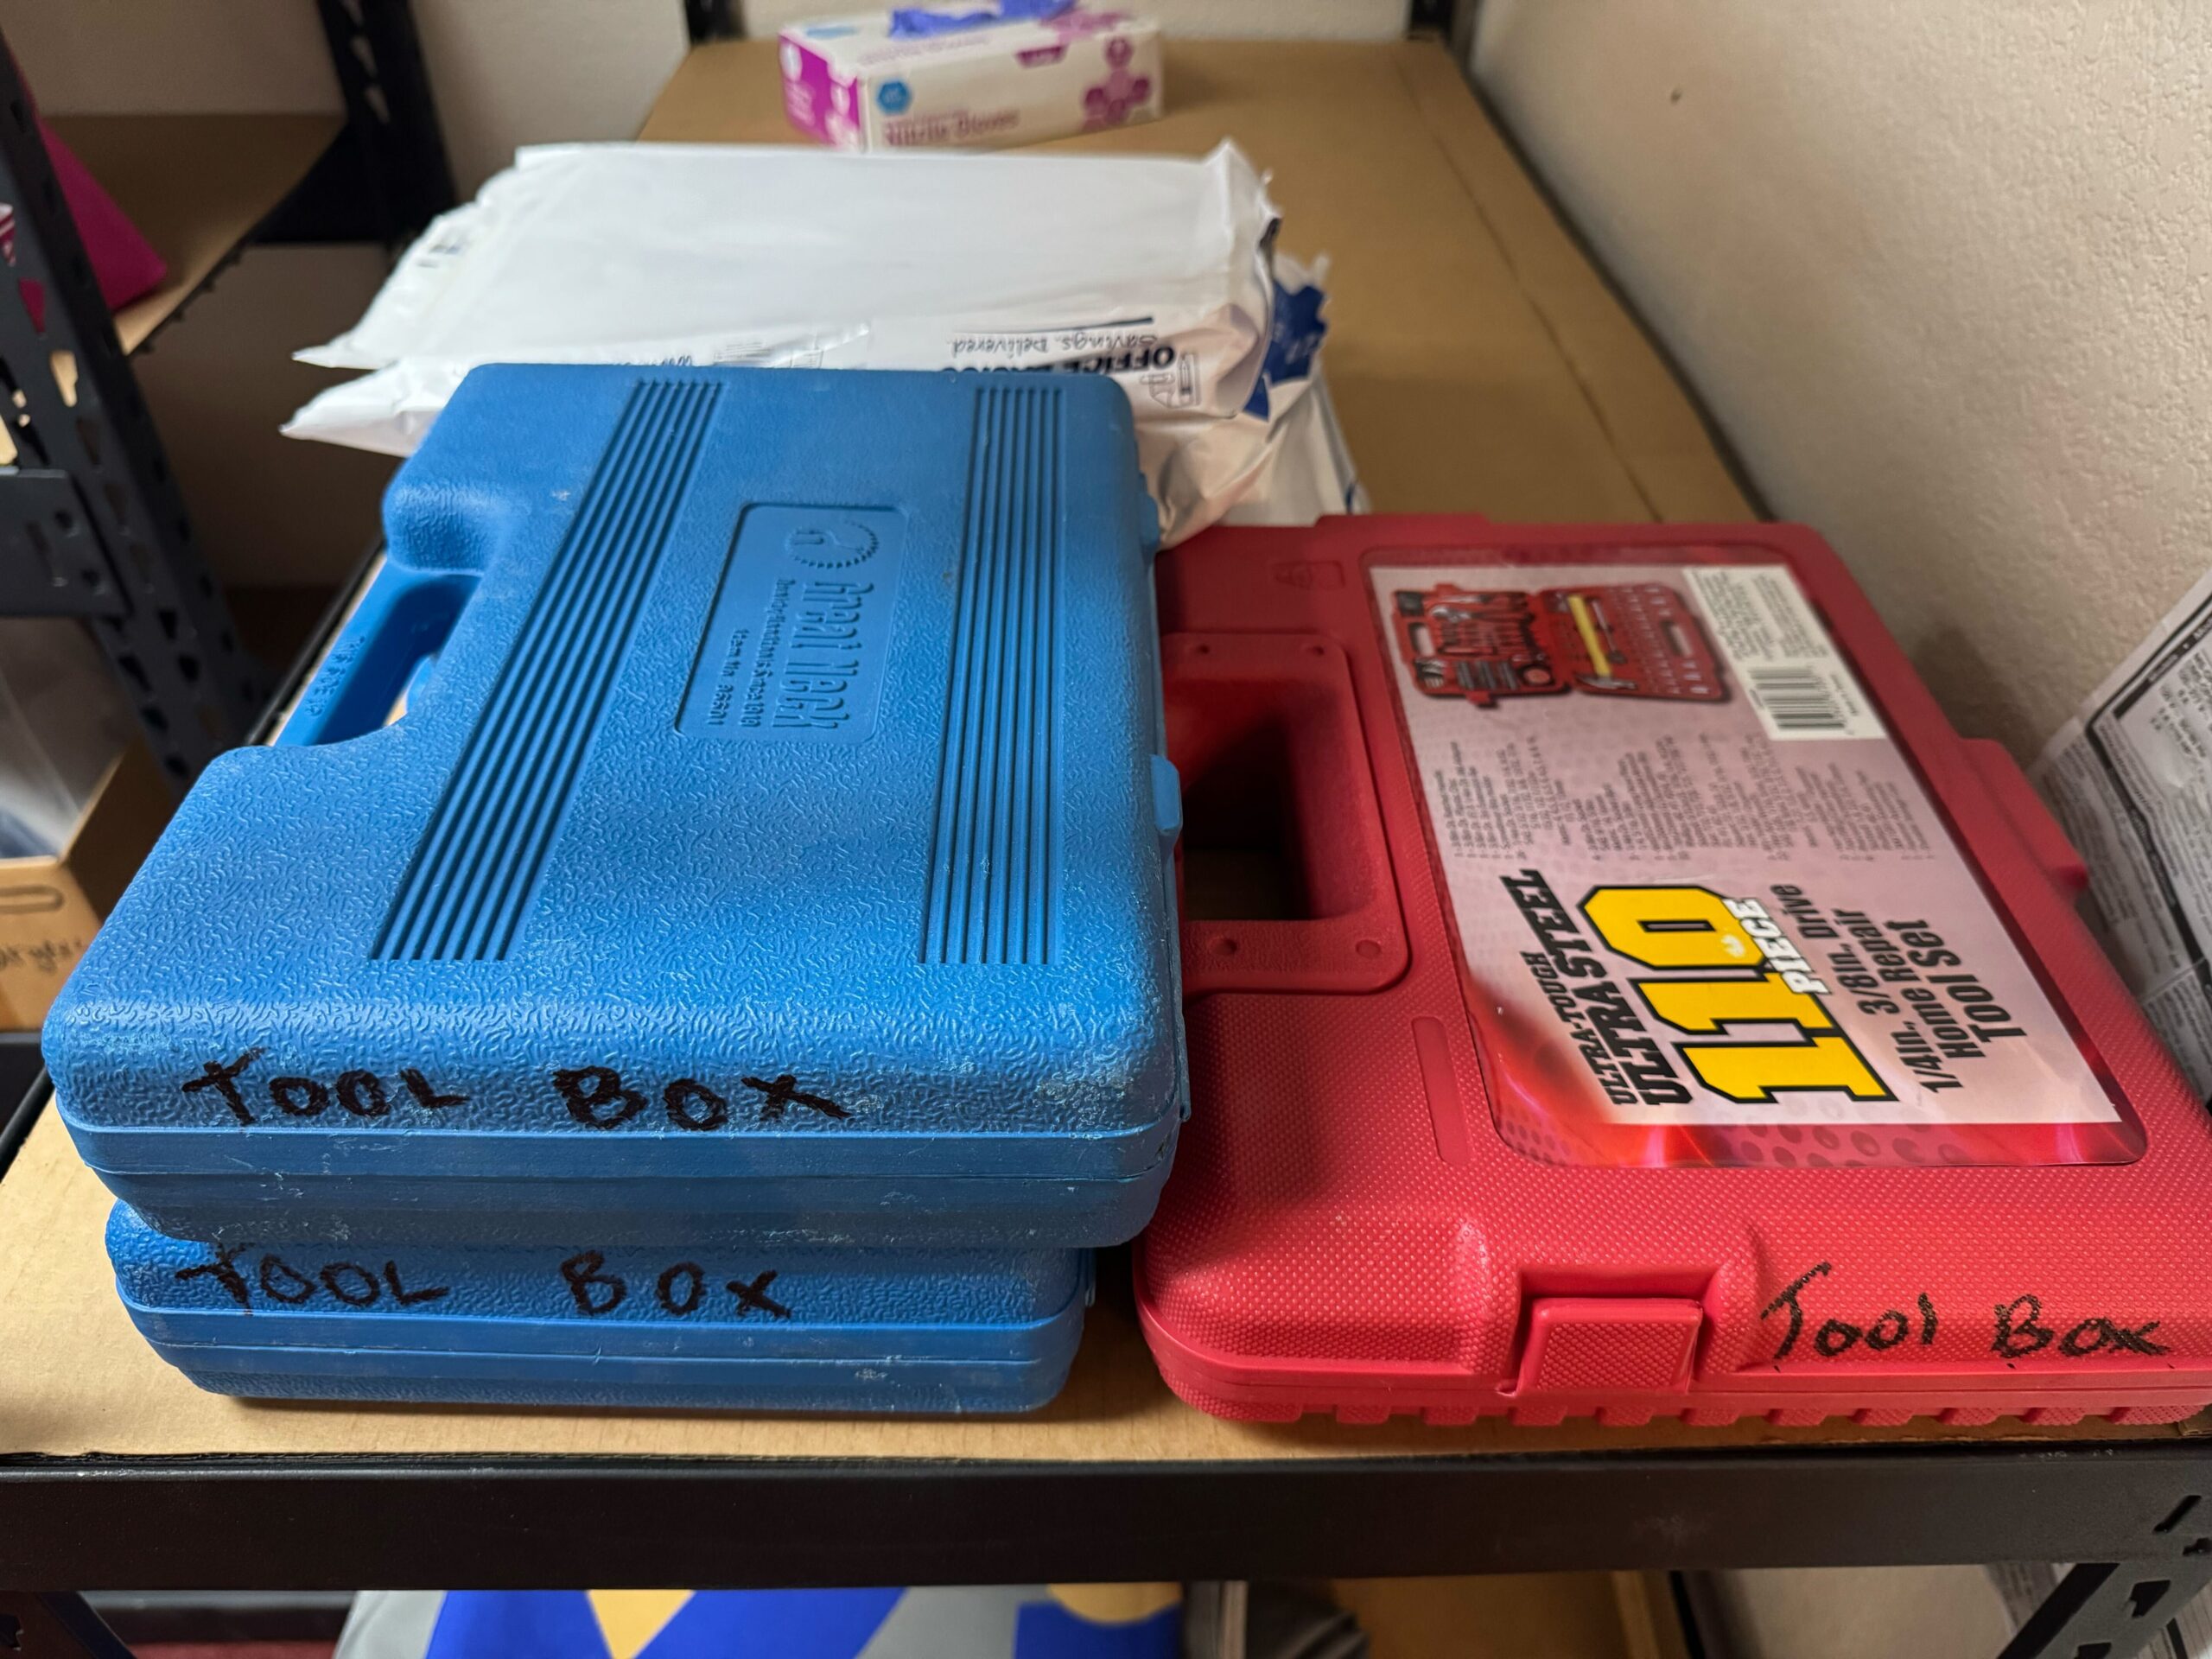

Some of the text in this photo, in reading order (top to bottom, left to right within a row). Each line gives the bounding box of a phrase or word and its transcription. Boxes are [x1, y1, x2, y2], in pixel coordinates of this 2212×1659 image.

[772, 582, 874, 728] Great Neck
[1499, 868, 1607, 978] STEEL
[1721, 897, 1831, 995] PIECE
[1770, 883, 1840, 940] Drive
[1831, 907, 1922, 982] Repair
[1520, 950, 1638, 1105] ULTRA-TOUGH
[1577, 885, 1900, 1104] 110
[1883, 919, 2028, 1043] Tool Set
[1901, 987, 1986, 1059] Home
[182, 1048, 852, 1132] TOOL BOX
[1572, 981, 1694, 1106] ULTRA
[175, 1242, 450, 1318] TOOL
[1759, 1262, 2175, 1361] Tool Box
